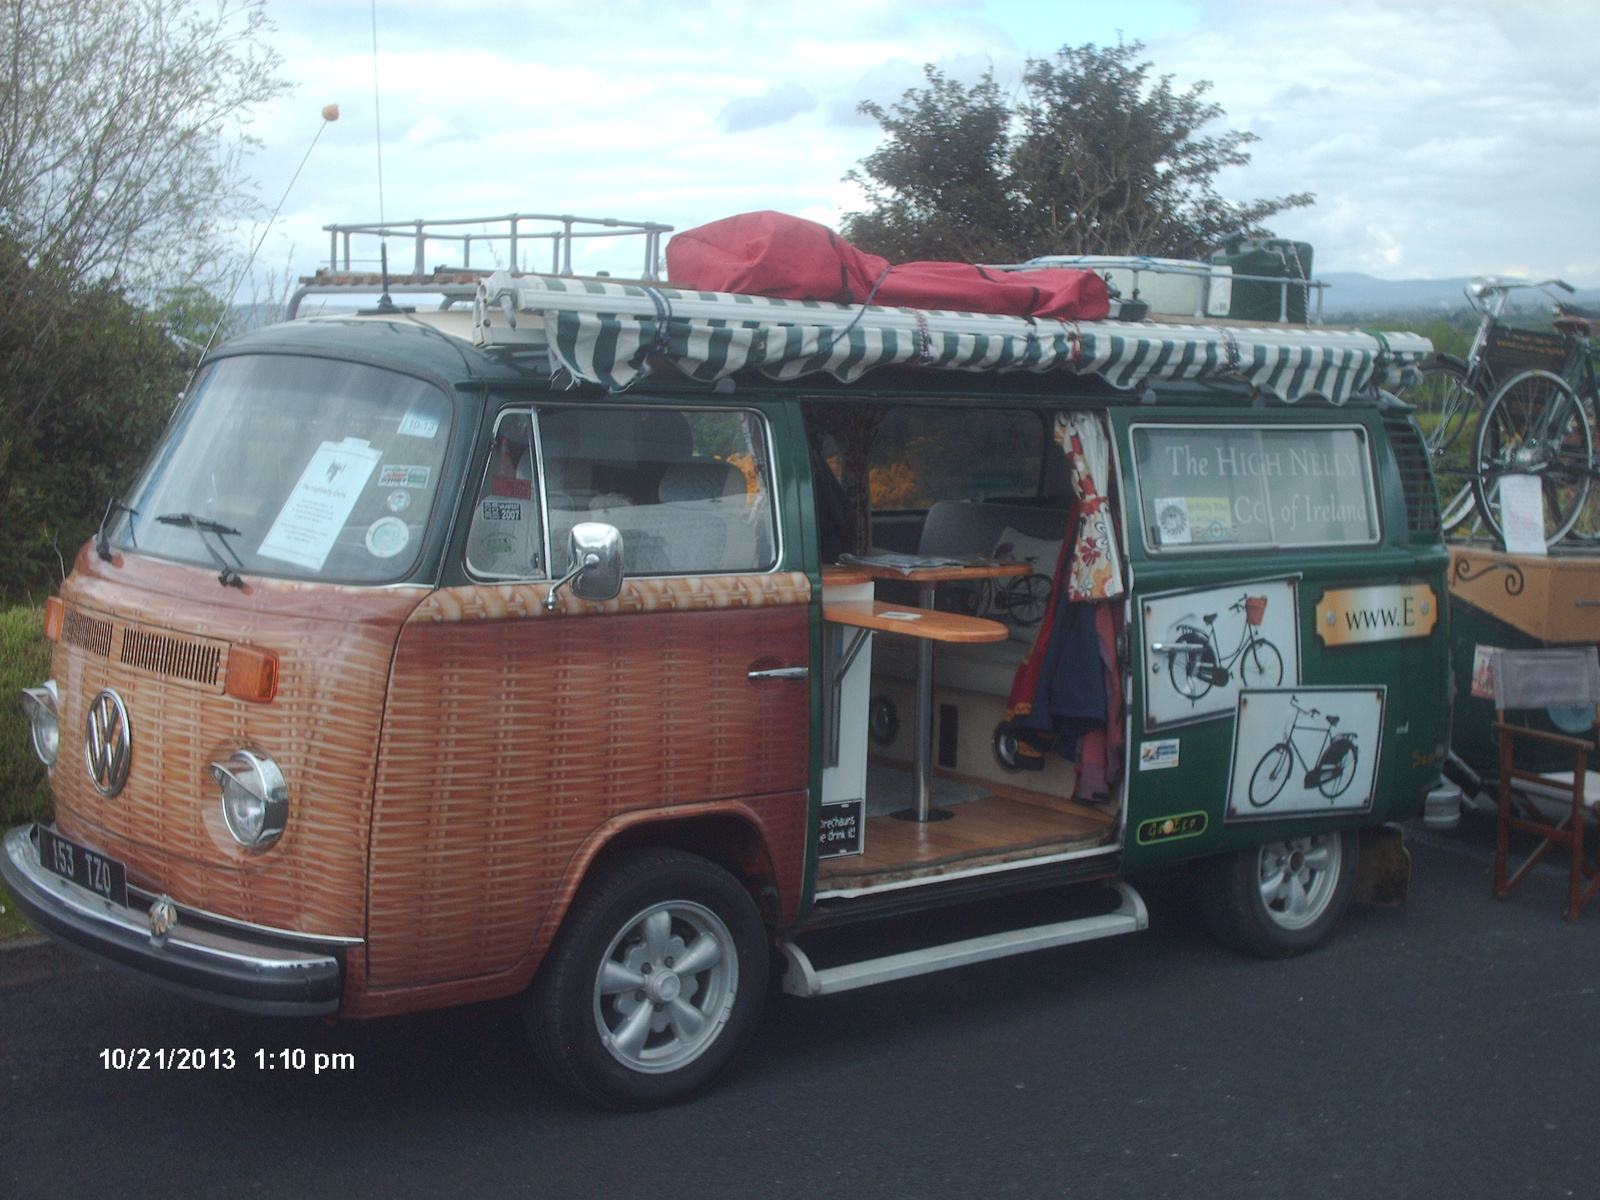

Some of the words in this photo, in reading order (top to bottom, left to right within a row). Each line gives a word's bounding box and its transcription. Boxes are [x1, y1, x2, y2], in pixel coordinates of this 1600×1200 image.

[410, 419, 437, 432] 10-13
[1166, 445, 1209, 476] The
[1215, 447, 1283, 477] HIGH
[1288, 448, 1360, 477] NELLY
[501, 510, 519, 520] 2007
[1281, 494, 1300, 532] of
[1304, 494, 1368, 522] Ireland
[1345, 596, 1415, 631] www.E
[827, 828, 846, 841] drink
[53, 838, 75, 878] 153
